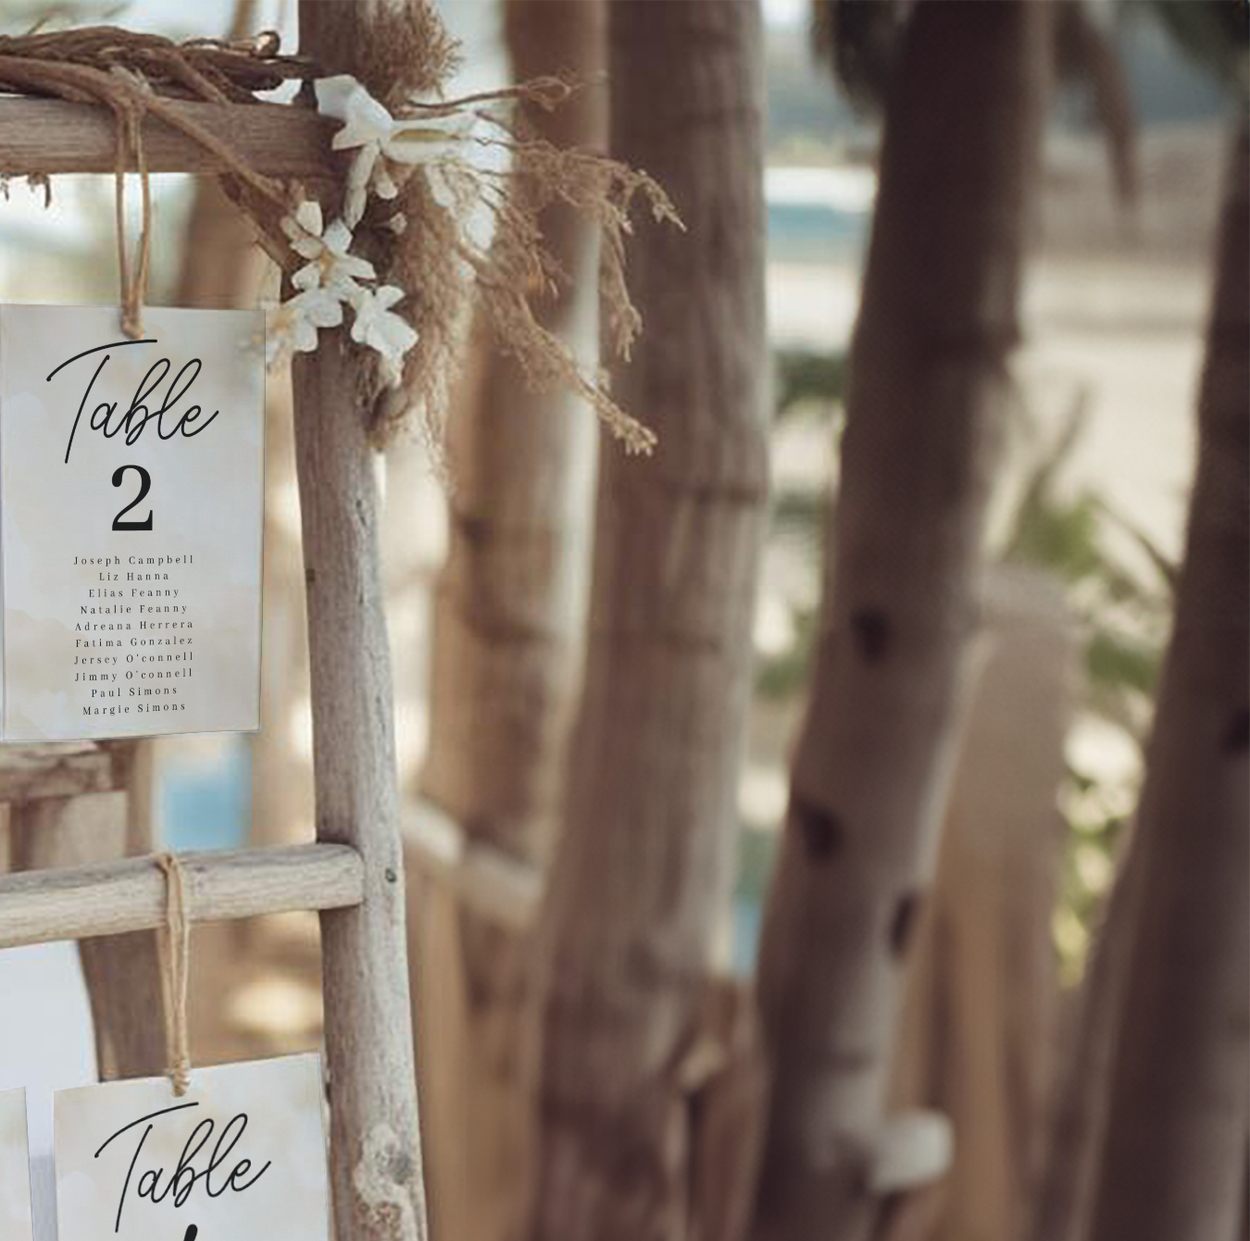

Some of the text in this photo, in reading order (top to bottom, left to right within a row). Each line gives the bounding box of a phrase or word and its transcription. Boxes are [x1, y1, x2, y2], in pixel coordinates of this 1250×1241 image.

[46, 338, 219, 464] Table
[111, 464, 154, 532] 2
[73, 555, 193, 567] Joseph Campbell
[99, 572, 169, 581] Liz Hanna
[89, 588, 179, 599] Elias Feanny
[80, 604, 187, 615] Natalie Feanny
[75, 620, 193, 631] Adreana Herrera
[76, 635, 193, 648] Fatima Gonzalez
[74, 656, 118, 666] Jersey
[74, 672, 117, 683] Jimmy
[91, 686, 177, 698] Paul Simons
[83, 703, 185, 716] Margie Simons
[94, 1102, 272, 1233] Table
